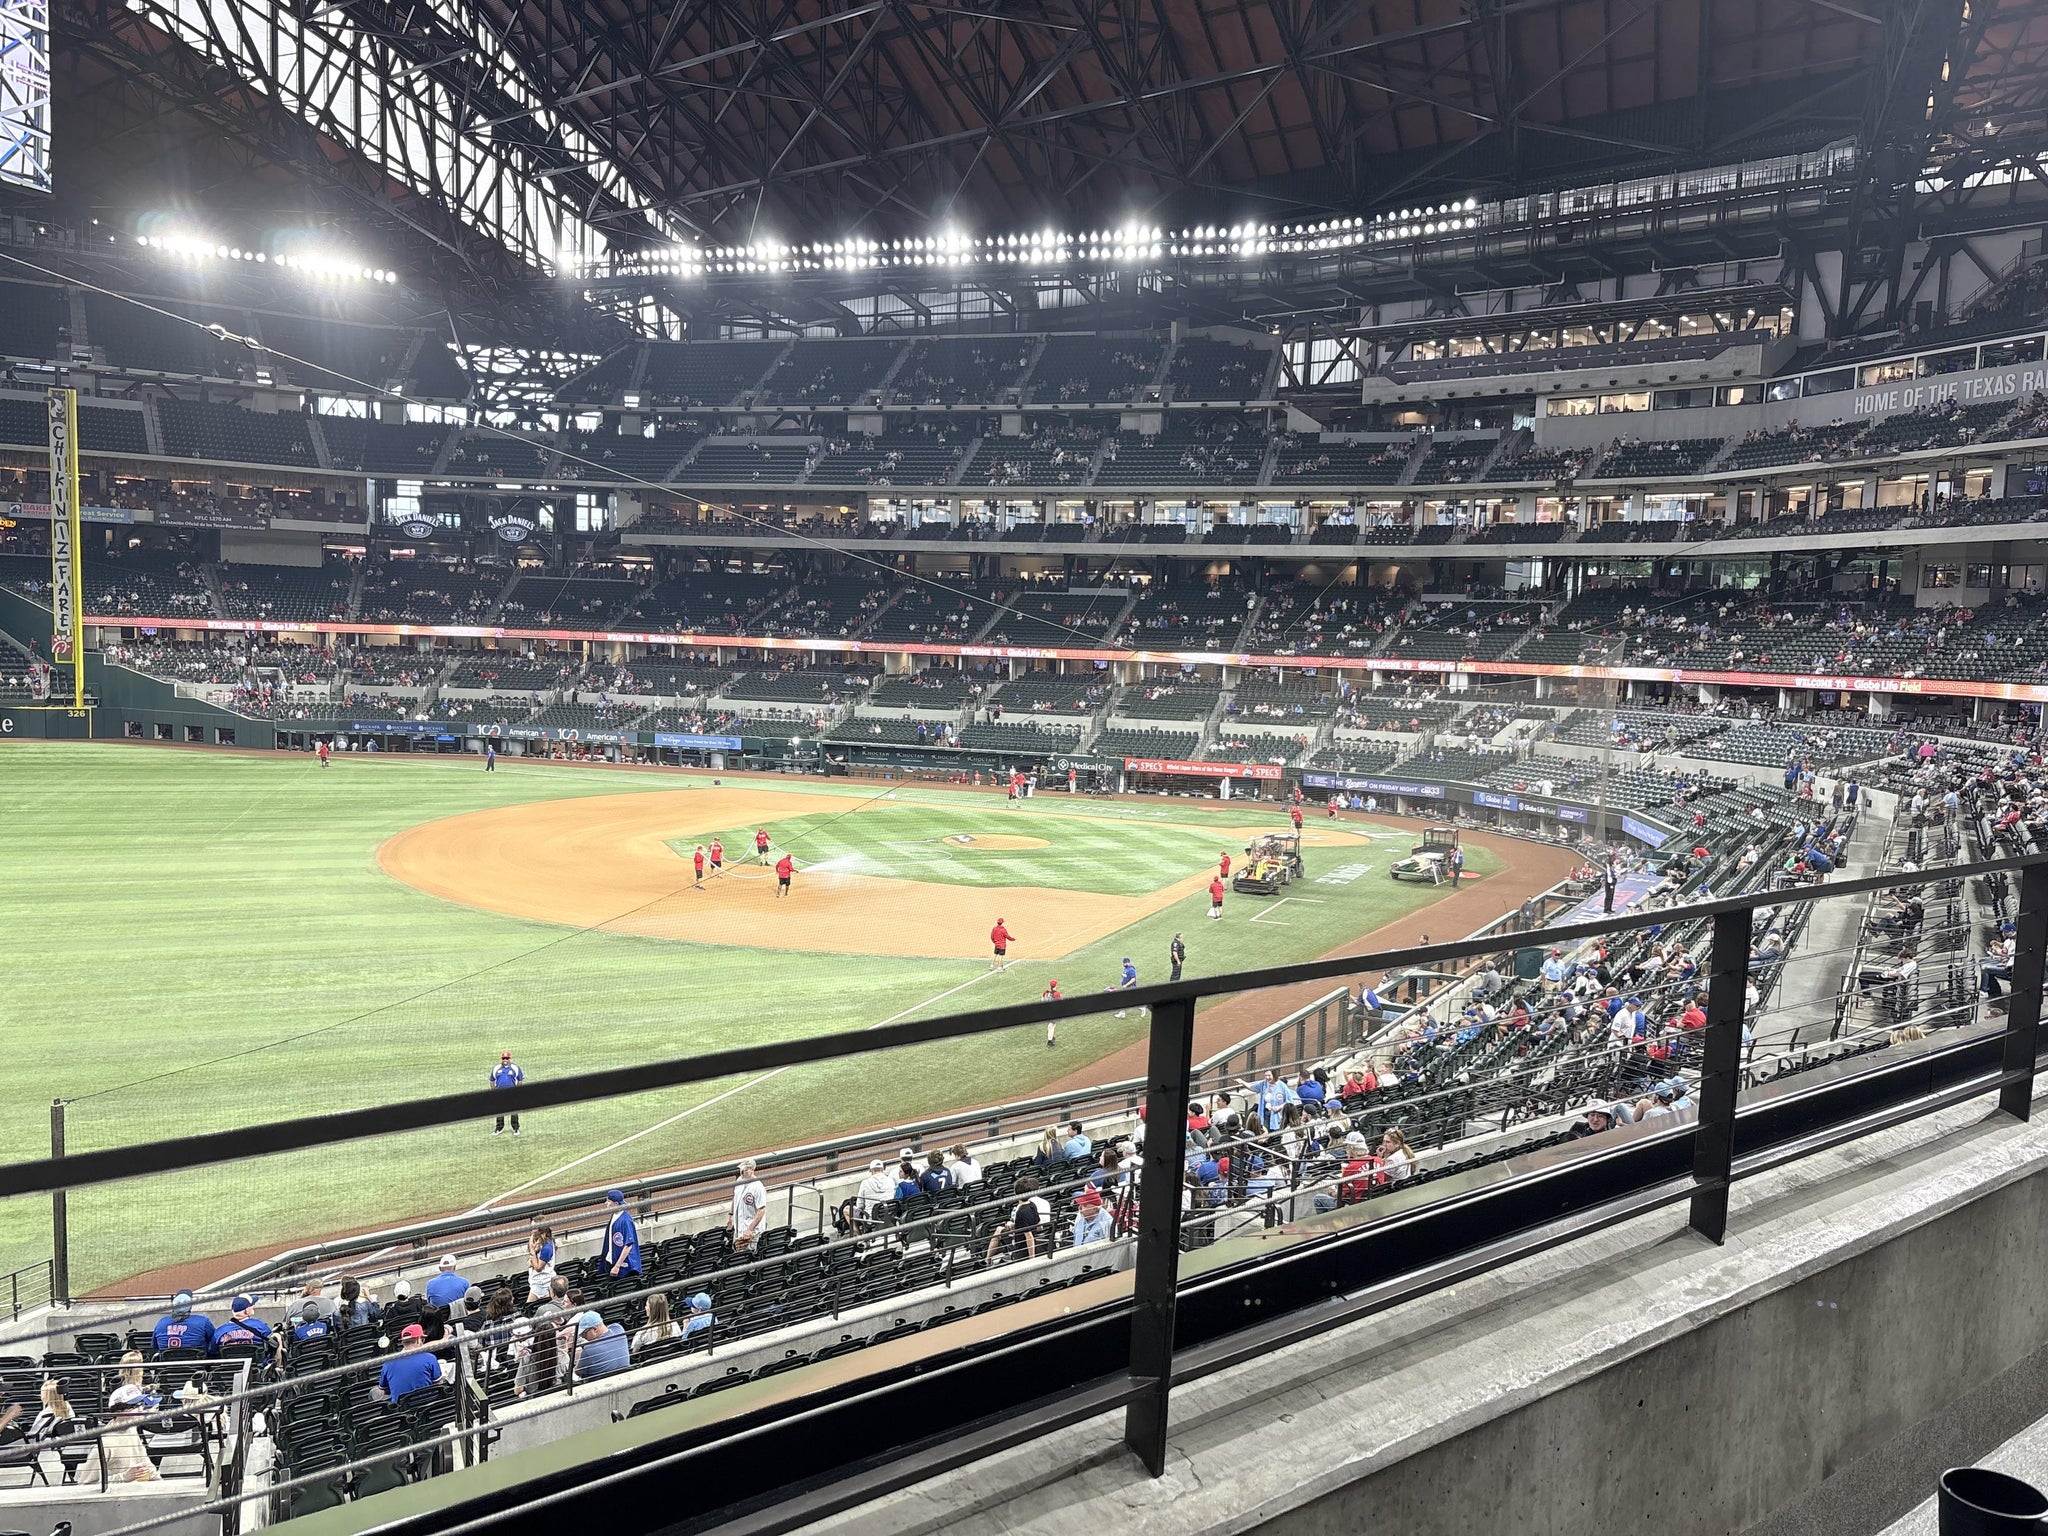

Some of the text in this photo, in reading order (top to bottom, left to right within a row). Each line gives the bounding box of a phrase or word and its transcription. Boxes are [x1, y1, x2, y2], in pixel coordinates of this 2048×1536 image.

[1854, 390, 1898, 415] HOME
[1903, 387, 1923, 407] OF
[1928, 382, 1958, 404] THE
[1964, 373, 2016, 399] TEXAS
[97, 510, 125, 518] Service
[395, 514, 412, 526] JACK
[52, 425, 70, 628] CHIKIN IZ FARE
[491, 515, 536, 531] JACK DANIEL'S
[1367, 660, 1400, 668] WELCOME
[1418, 661, 1440, 670] Globe
[1441, 662, 1455, 671] Life
[1457, 663, 1475, 672] Field
[1795, 678, 1921, 691] WELCOME TO Globe Life Field
[67, 710, 86, 718] 326
[509, 728, 539, 737] American
[586, 733, 617, 741] American
[1070, 762, 1098, 770] Medical
[1140, 761, 1163, 771] SPEC'S
[1255, 767, 1280, 777] SPEC'S
[1379, 784, 1399, 792] FRIDAY
[1485, 795, 1501, 804] Globe
[1524, 804, 1556, 816] Globe Life Field
[938, 1177, 946, 1189] 7
